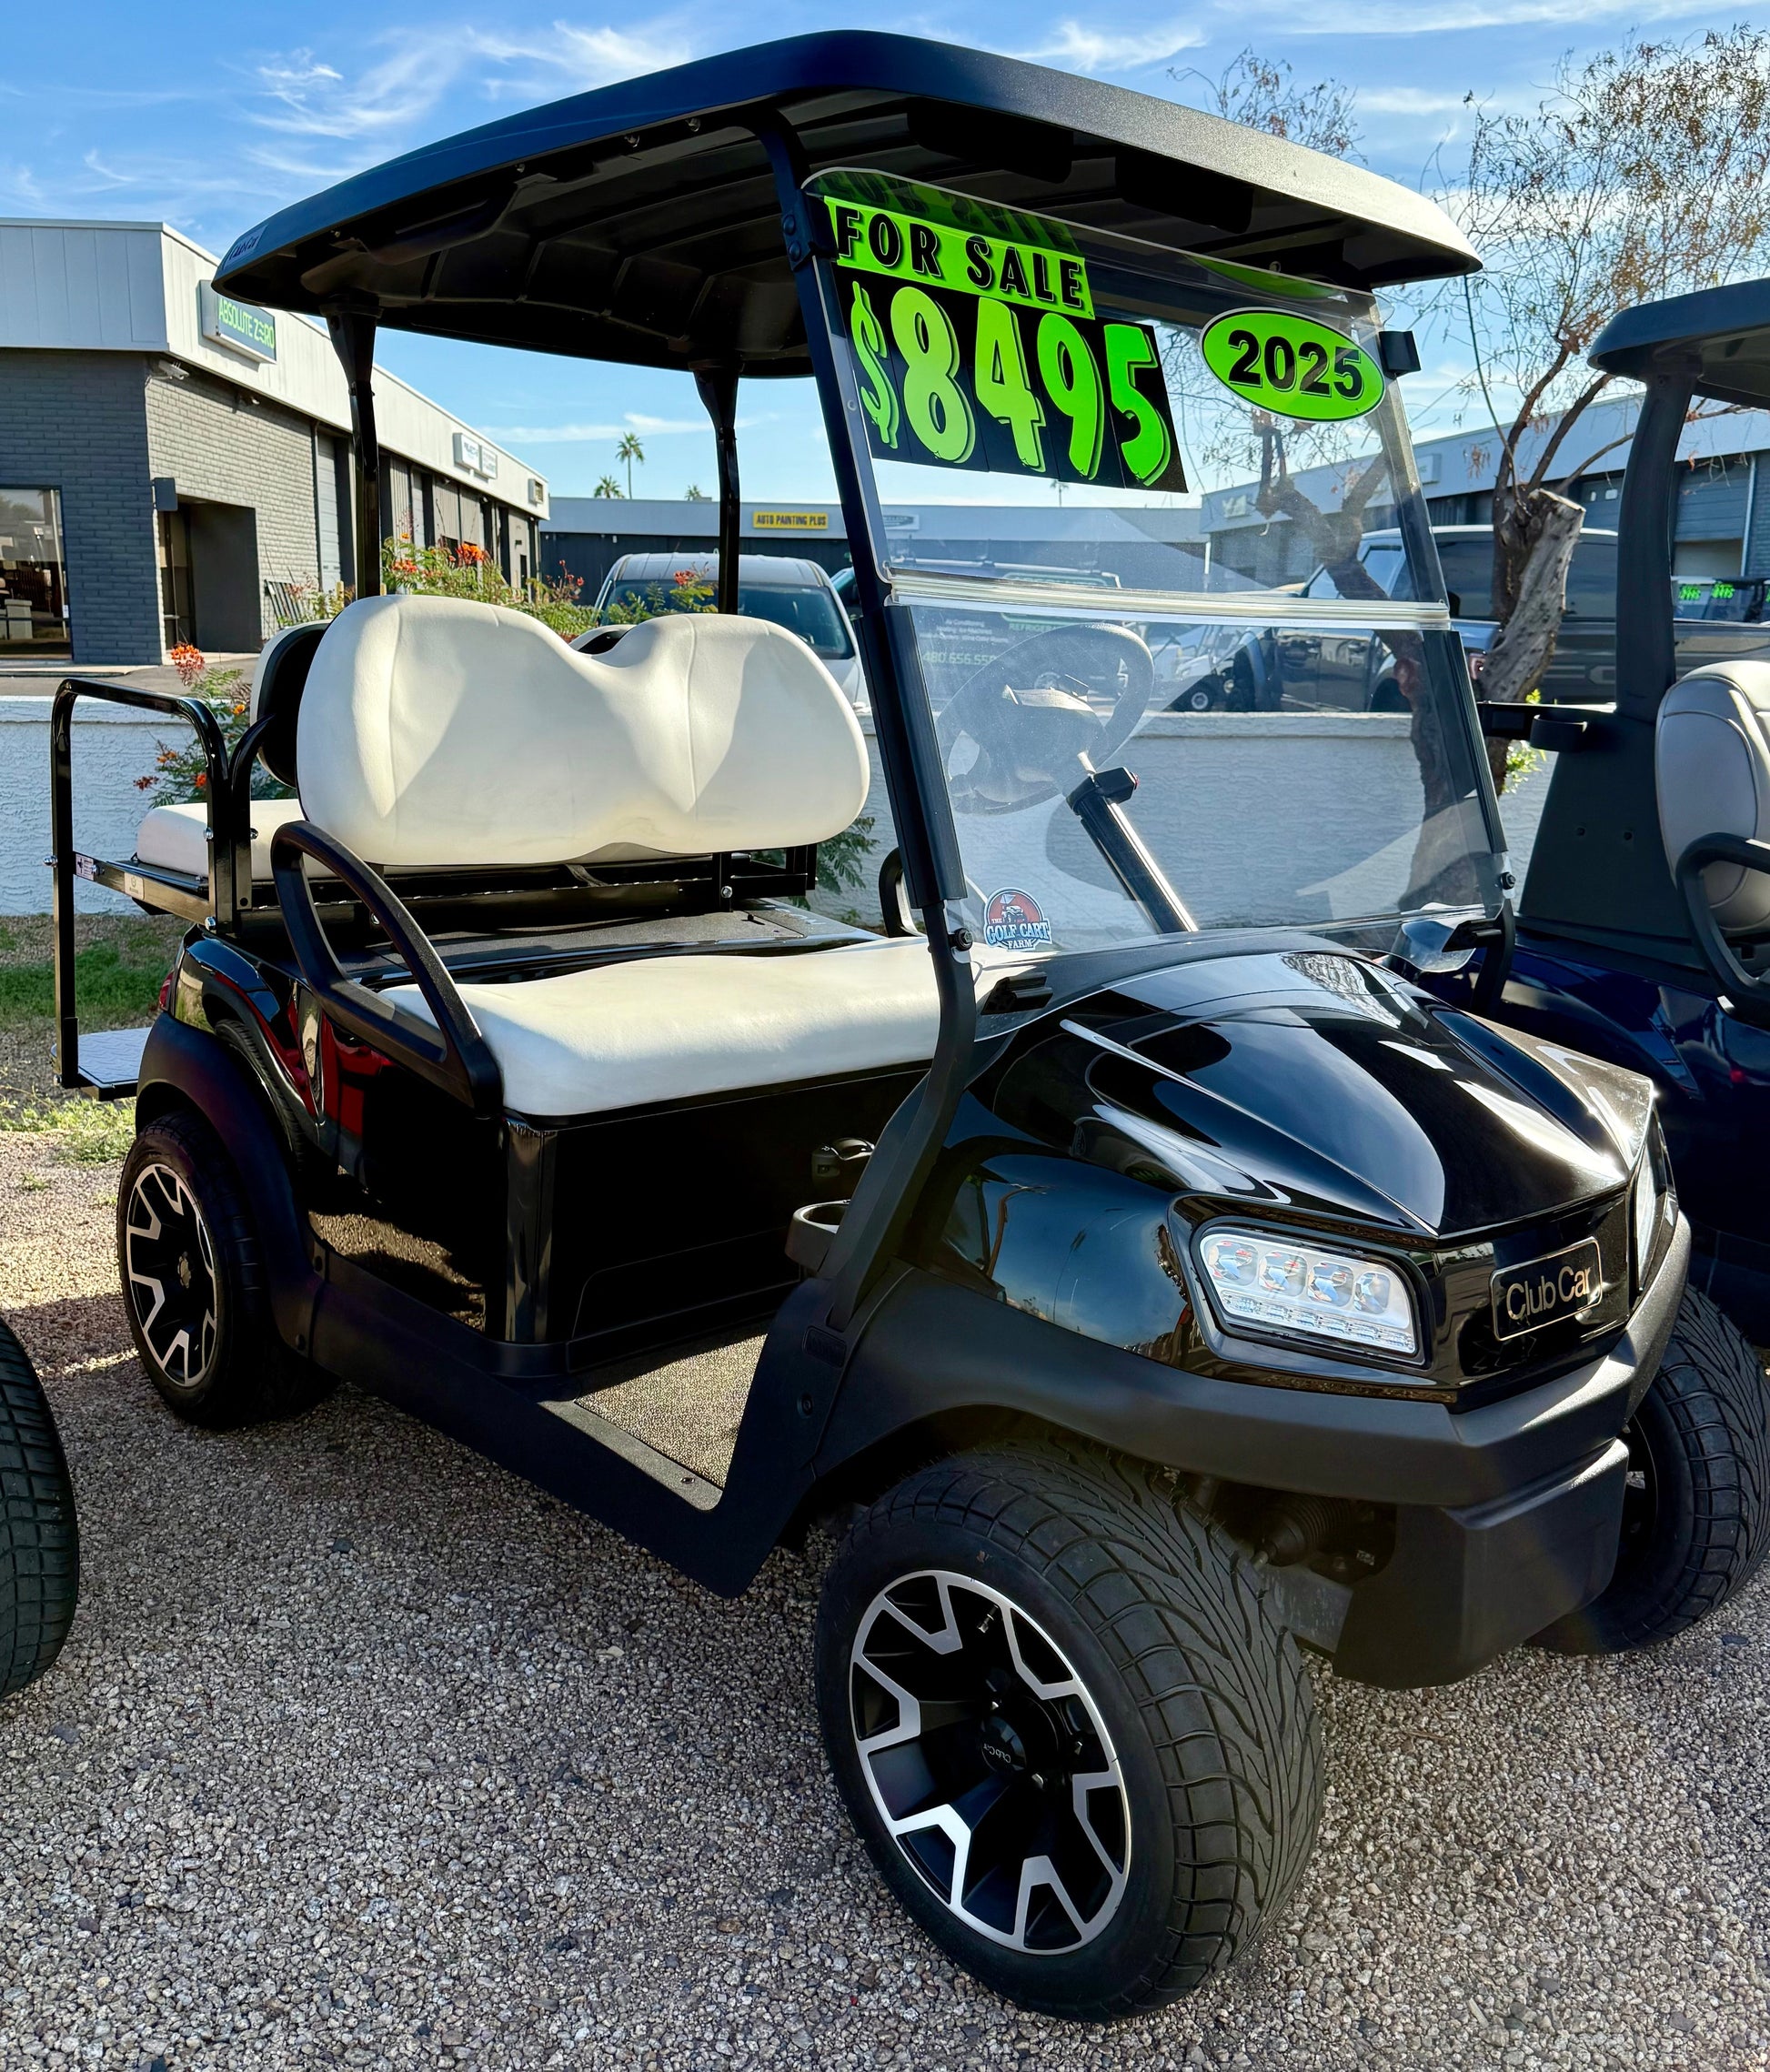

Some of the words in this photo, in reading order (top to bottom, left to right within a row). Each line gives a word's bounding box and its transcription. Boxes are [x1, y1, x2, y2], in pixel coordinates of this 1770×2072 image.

[835, 206, 942, 278] FOR
[964, 236, 1083, 308] SALE
[219, 297, 253, 337] ABSOLUTE
[253, 317, 275, 349] ZERO
[851, 280, 1171, 487] $8495
[1228, 329, 1363, 401] 2025
[757, 515, 774, 525] AUTO
[776, 516, 808, 526] PAINTING
[809, 517, 827, 527] PLUS
[986, 923, 1017, 944] GOLF
[1020, 921, 1051, 940] CART
[1007, 939, 1033, 949] FARM
[1505, 1275, 1556, 1320] Club
[1558, 1265, 1592, 1303] Car
